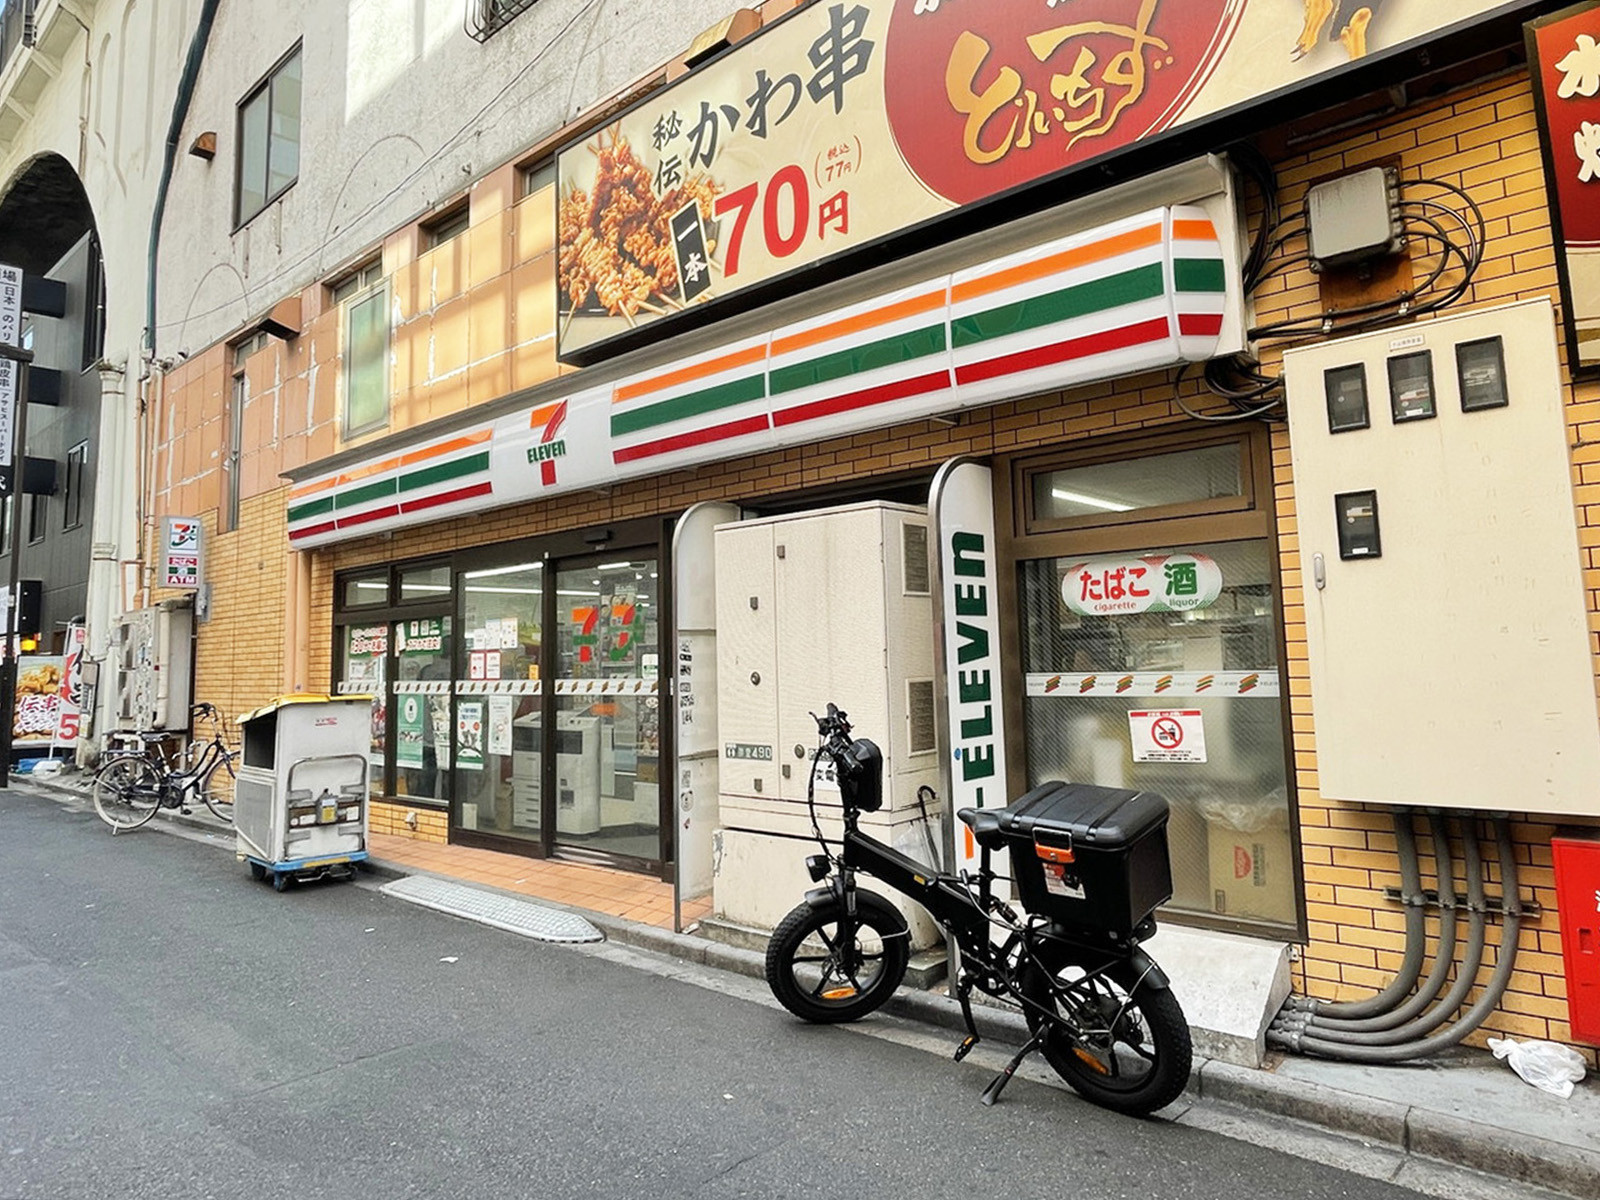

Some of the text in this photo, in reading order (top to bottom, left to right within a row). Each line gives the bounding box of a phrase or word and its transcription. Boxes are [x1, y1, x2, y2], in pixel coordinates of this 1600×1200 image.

[687, 3, 875, 169] かわ串
[652, 110, 683, 196] 秘伝
[676, 220, 708, 284] 一本
[169, 576, 196, 584] ATM
[1080, 562, 1197, 601] たばこ 酒
[1094, 598, 1199, 612] cigarette liquor
